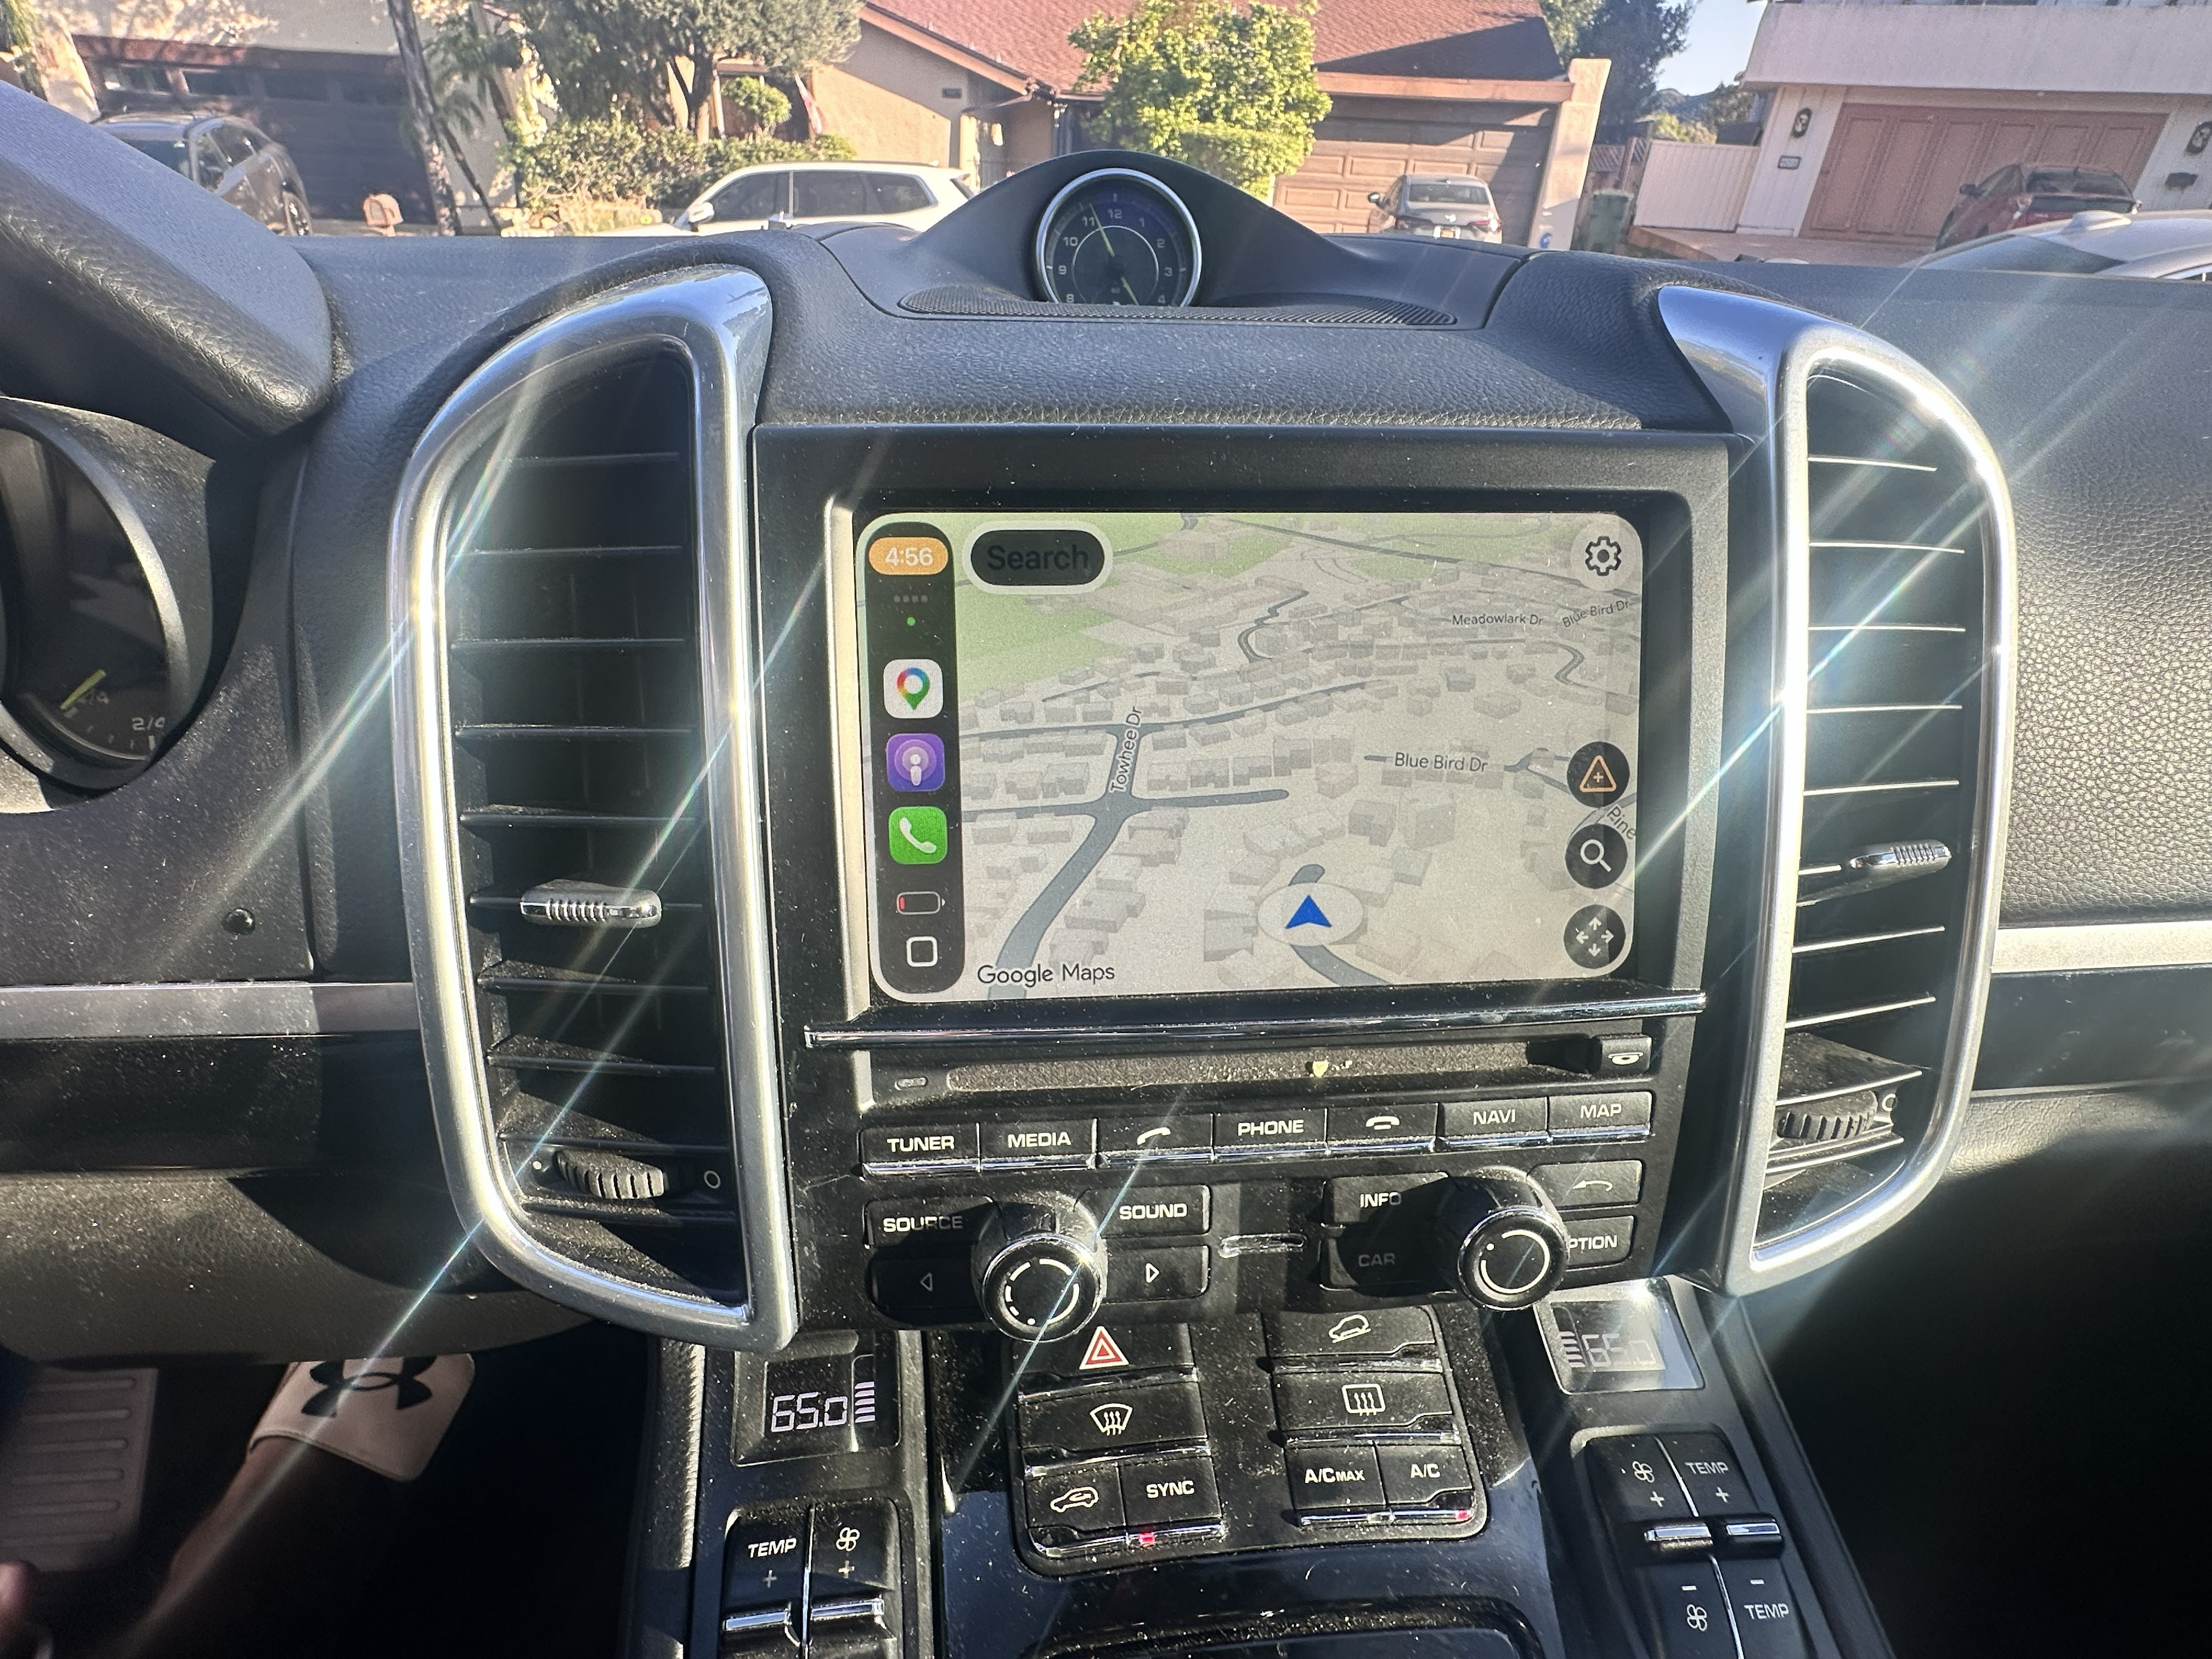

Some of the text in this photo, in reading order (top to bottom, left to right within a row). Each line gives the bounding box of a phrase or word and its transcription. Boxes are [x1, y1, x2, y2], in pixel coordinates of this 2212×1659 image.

[1107, 208, 1122, 219] 12
[1063, 236, 1078, 246] 10
[1157, 238, 1165, 247] 2
[1058, 264, 1067, 275] 9
[1164, 267, 1173, 276] 3
[885, 547, 934, 567] 4:56
[987, 544, 1089, 571] Search
[1452, 613, 1544, 625] Meadowlark Dr
[1562, 600, 1630, 628] Blue Bird Dr
[1110, 706, 1142, 791] Towhee Dr
[1394, 753, 1488, 772] Blue Bird Dr
[977, 963, 1115, 988] Google Maps
[1472, 1109, 1516, 1125] NAVI
[1579, 1103, 1622, 1119] MAP
[1237, 1119, 1304, 1136] PHONE
[887, 1135, 955, 1152] TUNER
[1007, 1131, 1071, 1148] MEDIA
[1359, 1192, 1402, 1209] INFO
[1119, 1203, 1188, 1220] SOUND
[883, 1215, 964, 1233] SOURCE
[1565, 1234, 1618, 1250] PTION
[1358, 1252, 1396, 1268] CAR
[770, 1391, 849, 1434] 65.0
[1410, 1463, 1441, 1479] A/C
[1685, 1460, 1729, 1476] TEMP
[1146, 1480, 1195, 1498] SYNC
[747, 1537, 797, 1559] TEMP
[1743, 1602, 1790, 1620] TEMP
